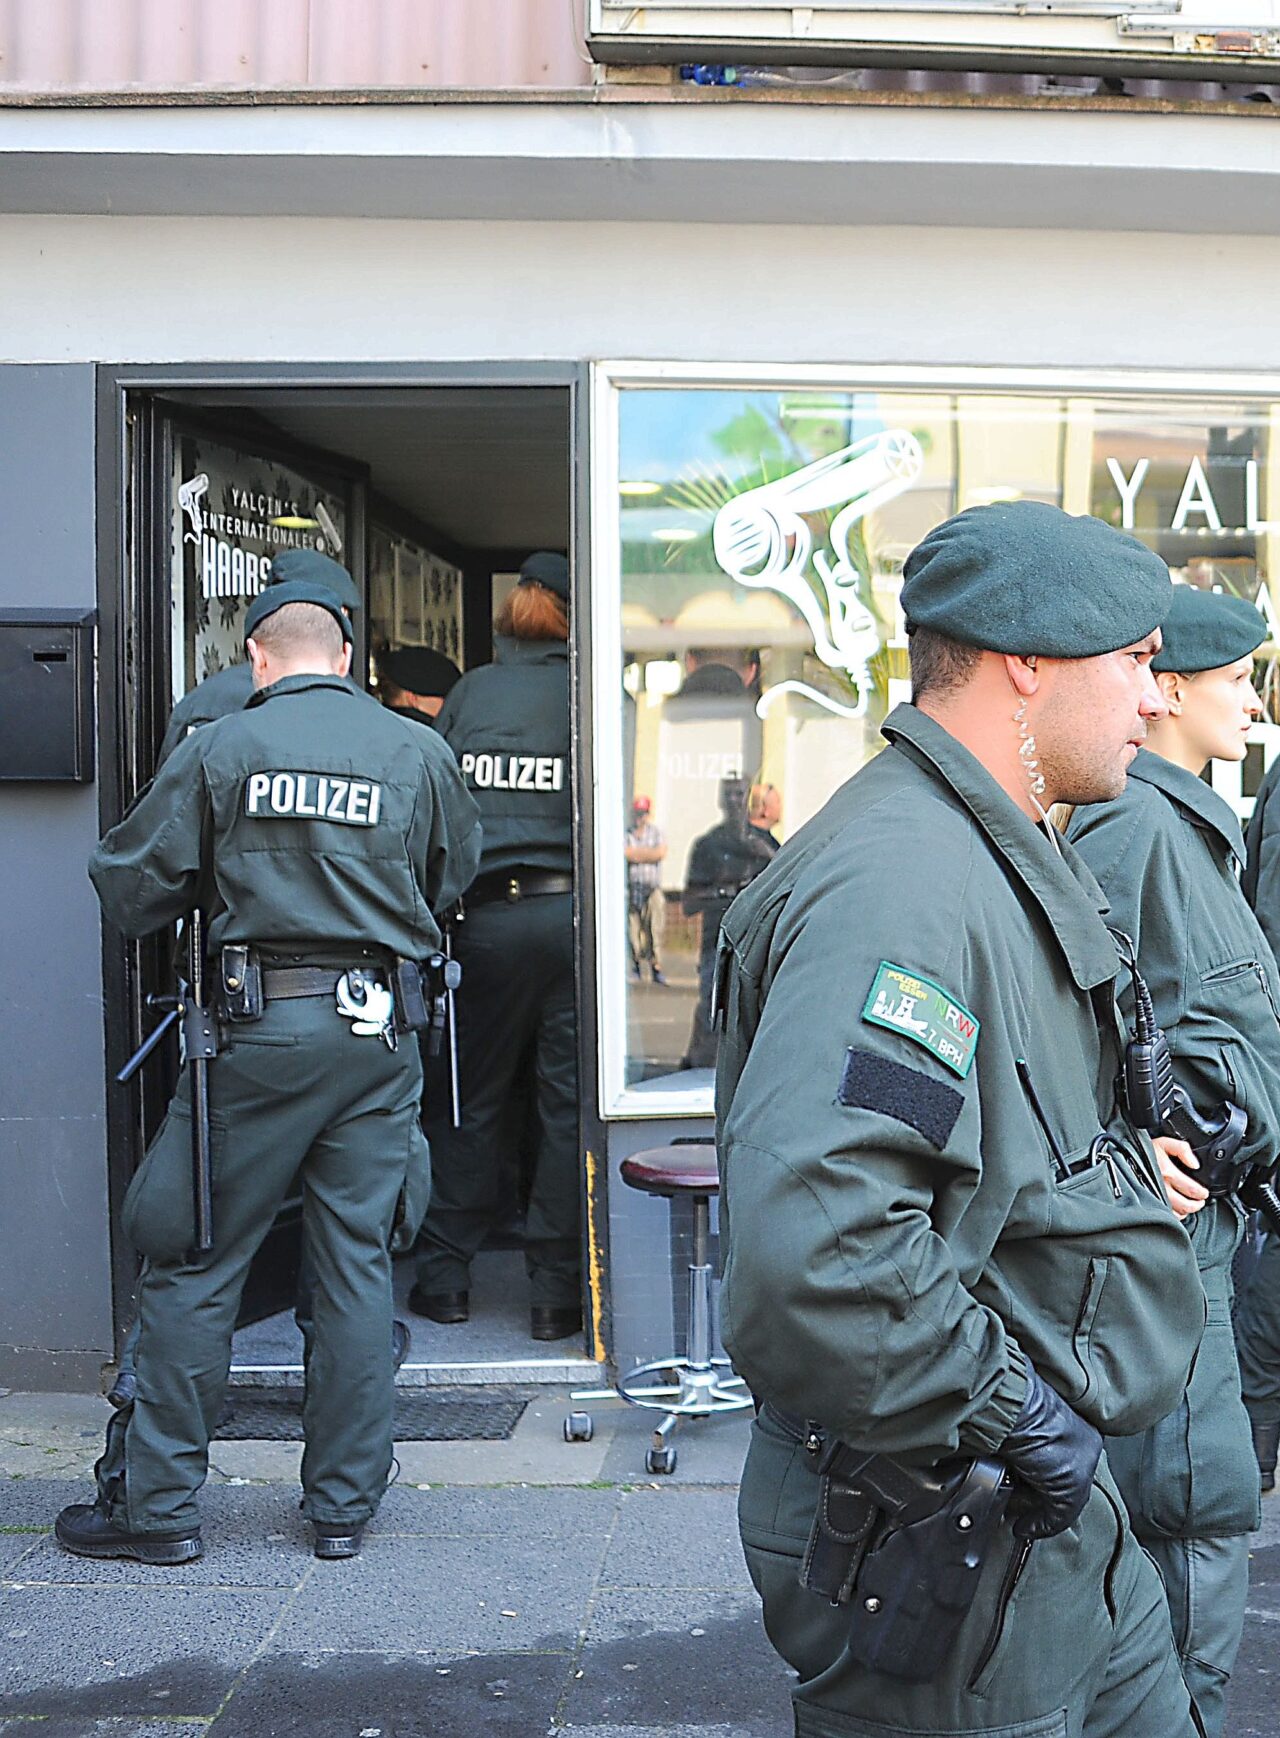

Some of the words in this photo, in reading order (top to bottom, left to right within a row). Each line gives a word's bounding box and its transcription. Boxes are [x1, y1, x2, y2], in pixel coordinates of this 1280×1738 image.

[202, 511, 315, 550] INTERNATIONALES
[461, 753, 563, 791] POLIZEI
[247, 773, 382, 824] POLIZEI
[934, 993, 976, 1038] NRW
[937, 1038, 964, 1066] BPH
